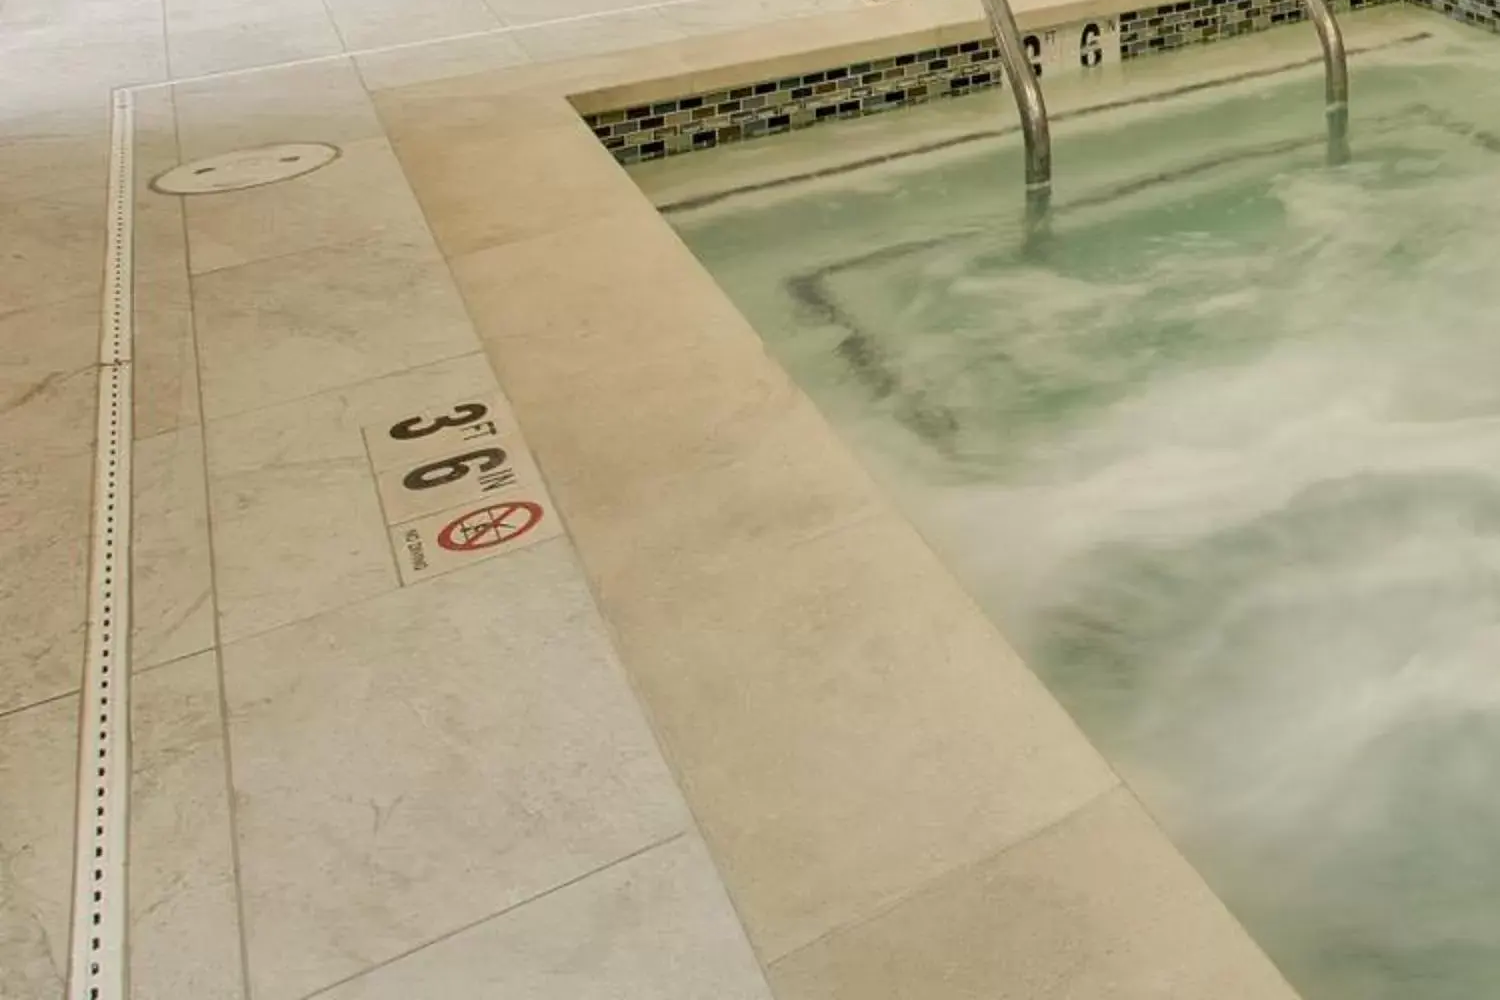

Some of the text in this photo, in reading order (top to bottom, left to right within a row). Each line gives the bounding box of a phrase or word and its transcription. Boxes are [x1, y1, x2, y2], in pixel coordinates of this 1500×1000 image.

[1080, 23, 1103, 68] 6
[389, 403, 488, 440] 3
[460, 420, 498, 441] FT
[403, 447, 507, 491] 6
